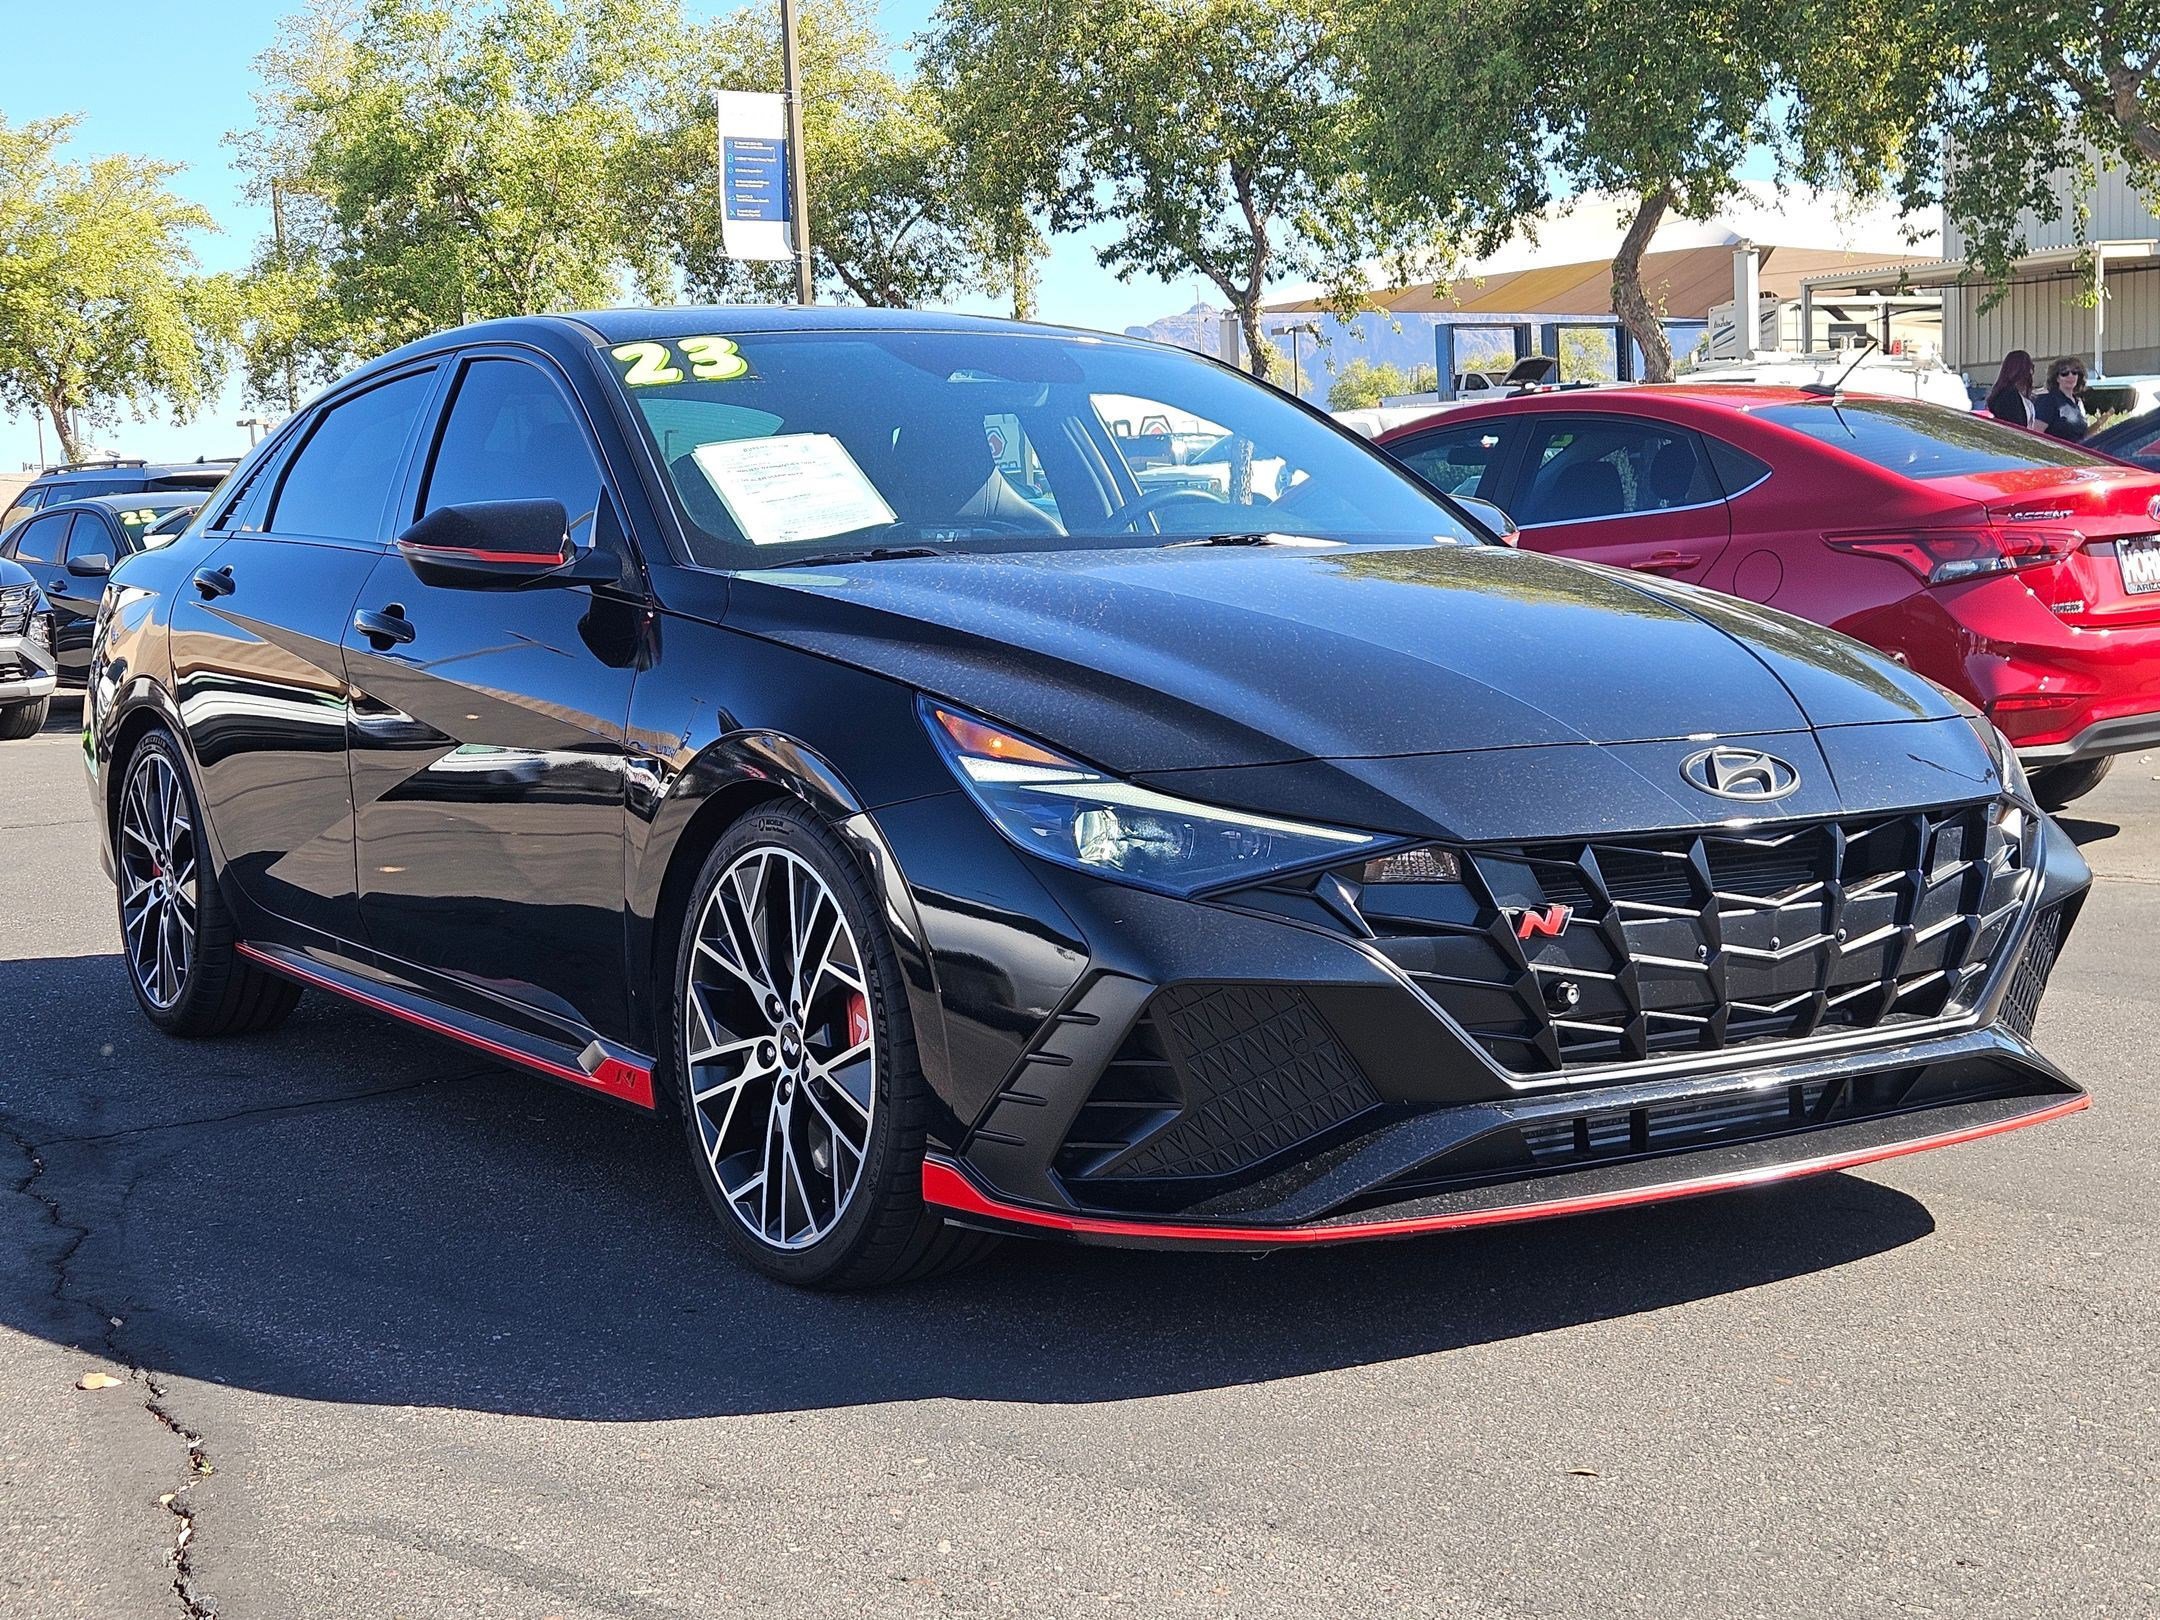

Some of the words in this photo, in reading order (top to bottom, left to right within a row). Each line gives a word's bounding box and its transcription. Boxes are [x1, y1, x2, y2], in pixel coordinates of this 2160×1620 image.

[611, 336, 748, 387] 23
[120, 509, 157, 525] 25
[2007, 509, 2074, 521] ACCENT
[1518, 905, 1572, 939] N
[870, 968, 891, 1098] MICHELIN
